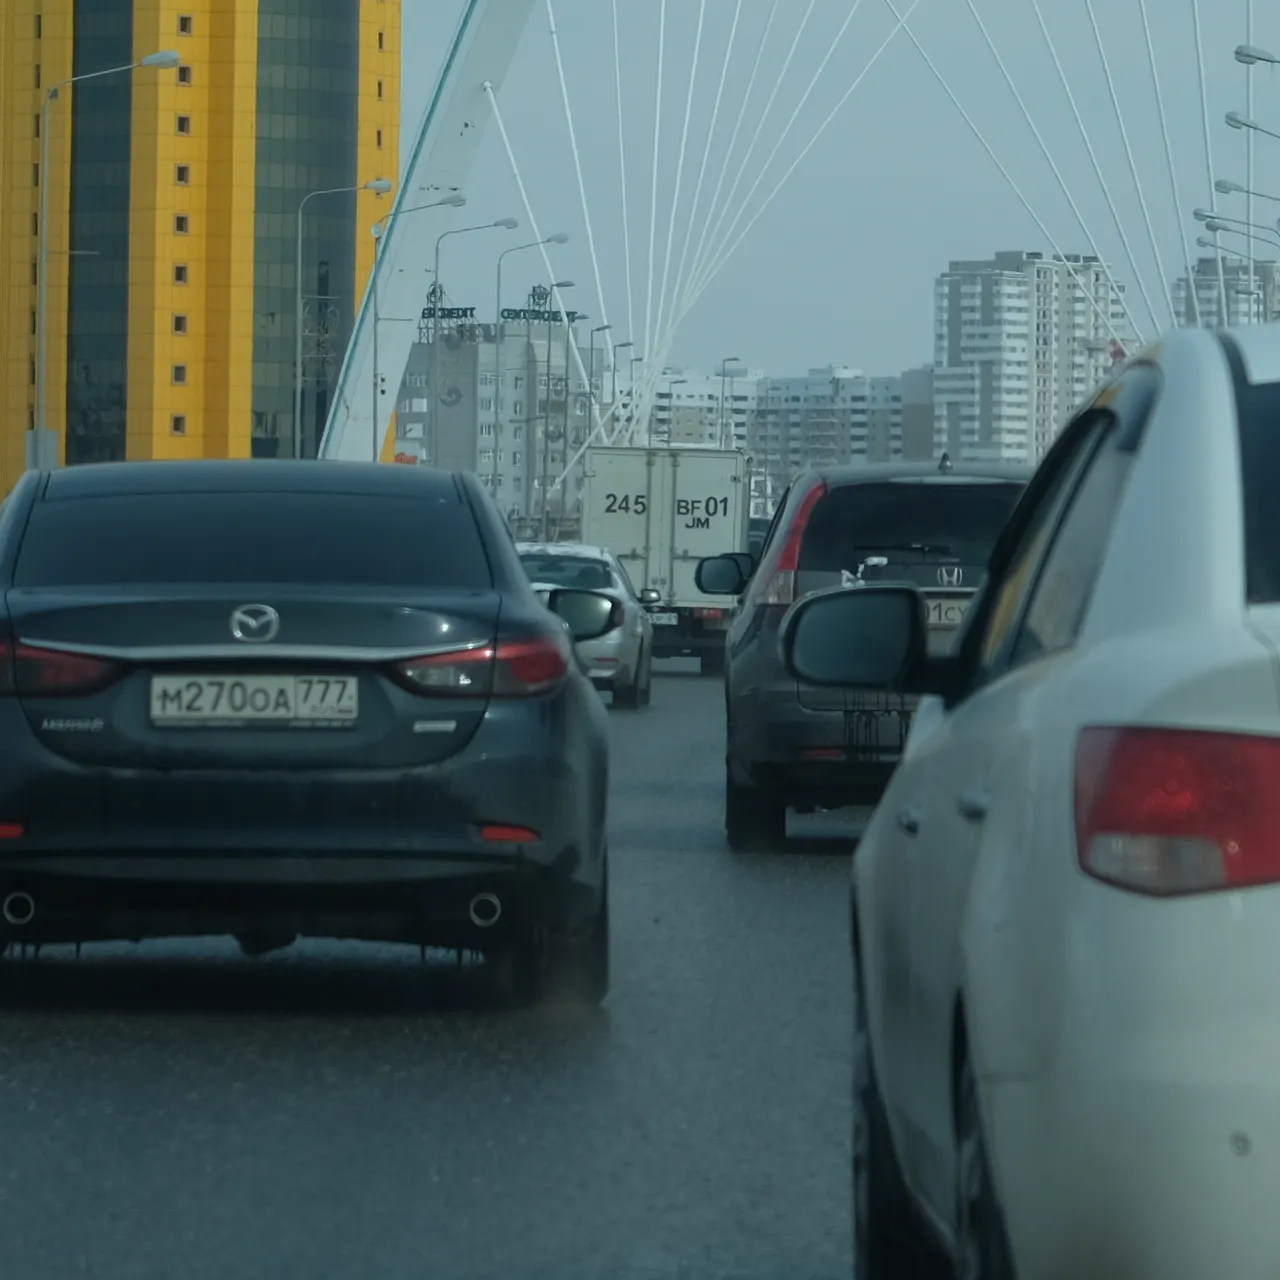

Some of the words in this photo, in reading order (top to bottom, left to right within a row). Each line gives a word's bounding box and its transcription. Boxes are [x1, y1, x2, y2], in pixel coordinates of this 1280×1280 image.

[501, 308, 578, 323] CENTERCREIT
[605, 493, 647, 515] 245
[685, 517, 710, 529] JM
[298, 679, 350, 705] 777
